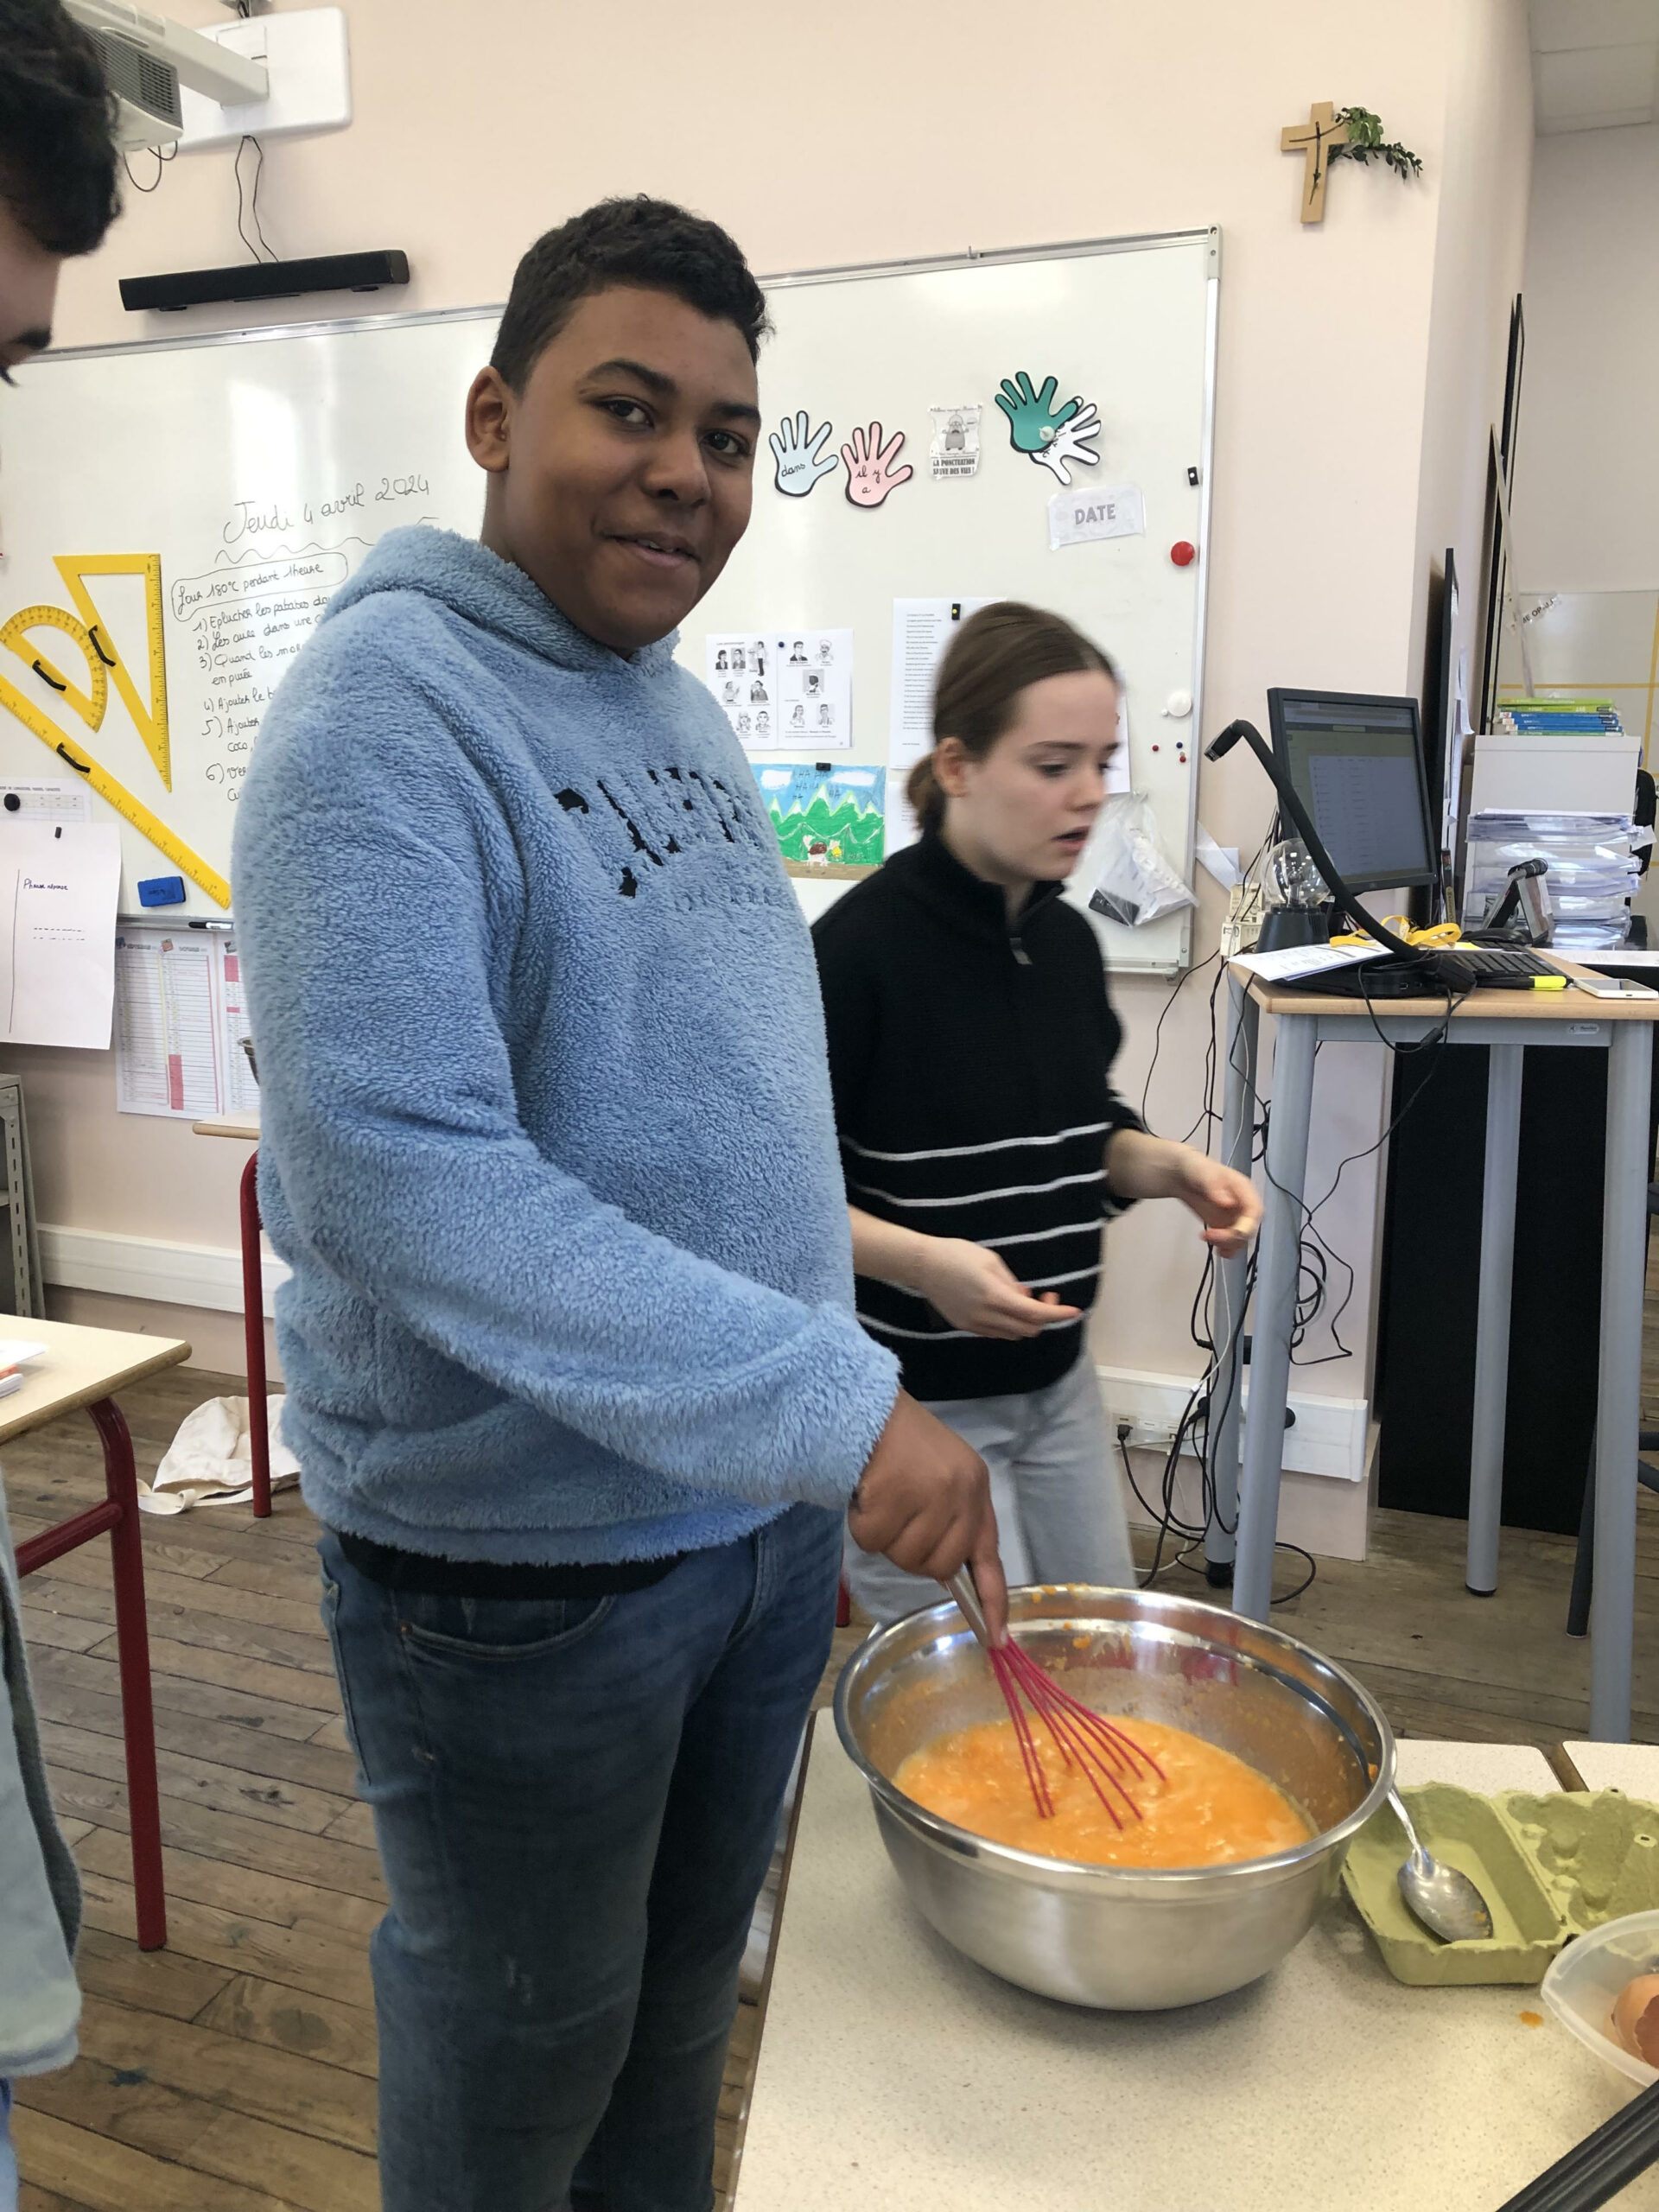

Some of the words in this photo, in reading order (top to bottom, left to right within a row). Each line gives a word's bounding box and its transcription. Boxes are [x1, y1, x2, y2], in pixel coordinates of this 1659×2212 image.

[781, 463, 806, 477] dans
[941, 458, 975, 467] PONCTUATION
[855, 465, 868, 479] il
[872, 471, 882, 483] y
[223, 501, 294, 543] Jeudi
[303, 503, 314, 524] 4
[321, 483, 365, 517] avril
[375, 474, 429, 501] 2024
[1074, 504, 1116, 524] DATE
[243, 570, 280, 592] pendant
[210, 608, 252, 629] Eplucher
[256, 603, 271, 617] les
[274, 597, 309, 616] patates
[197, 635, 209, 651] 2)
[212, 631, 230, 652] Les
[264, 622, 290, 636] dans
[294, 616, 312, 626] une
[200, 652, 213, 671] 3)
[213, 650, 256, 668] Quand
[259, 645, 273, 659] les
[212, 676, 226, 685] en
[229, 668, 252, 687] purée
[203, 697, 214, 712] 4)
[219, 694, 251, 713] Ajouter
[252, 687, 264, 702] le
[201, 715, 223, 738] 5)
[227, 717, 259, 736] Ajouter
[206, 763, 224, 784] 6)
